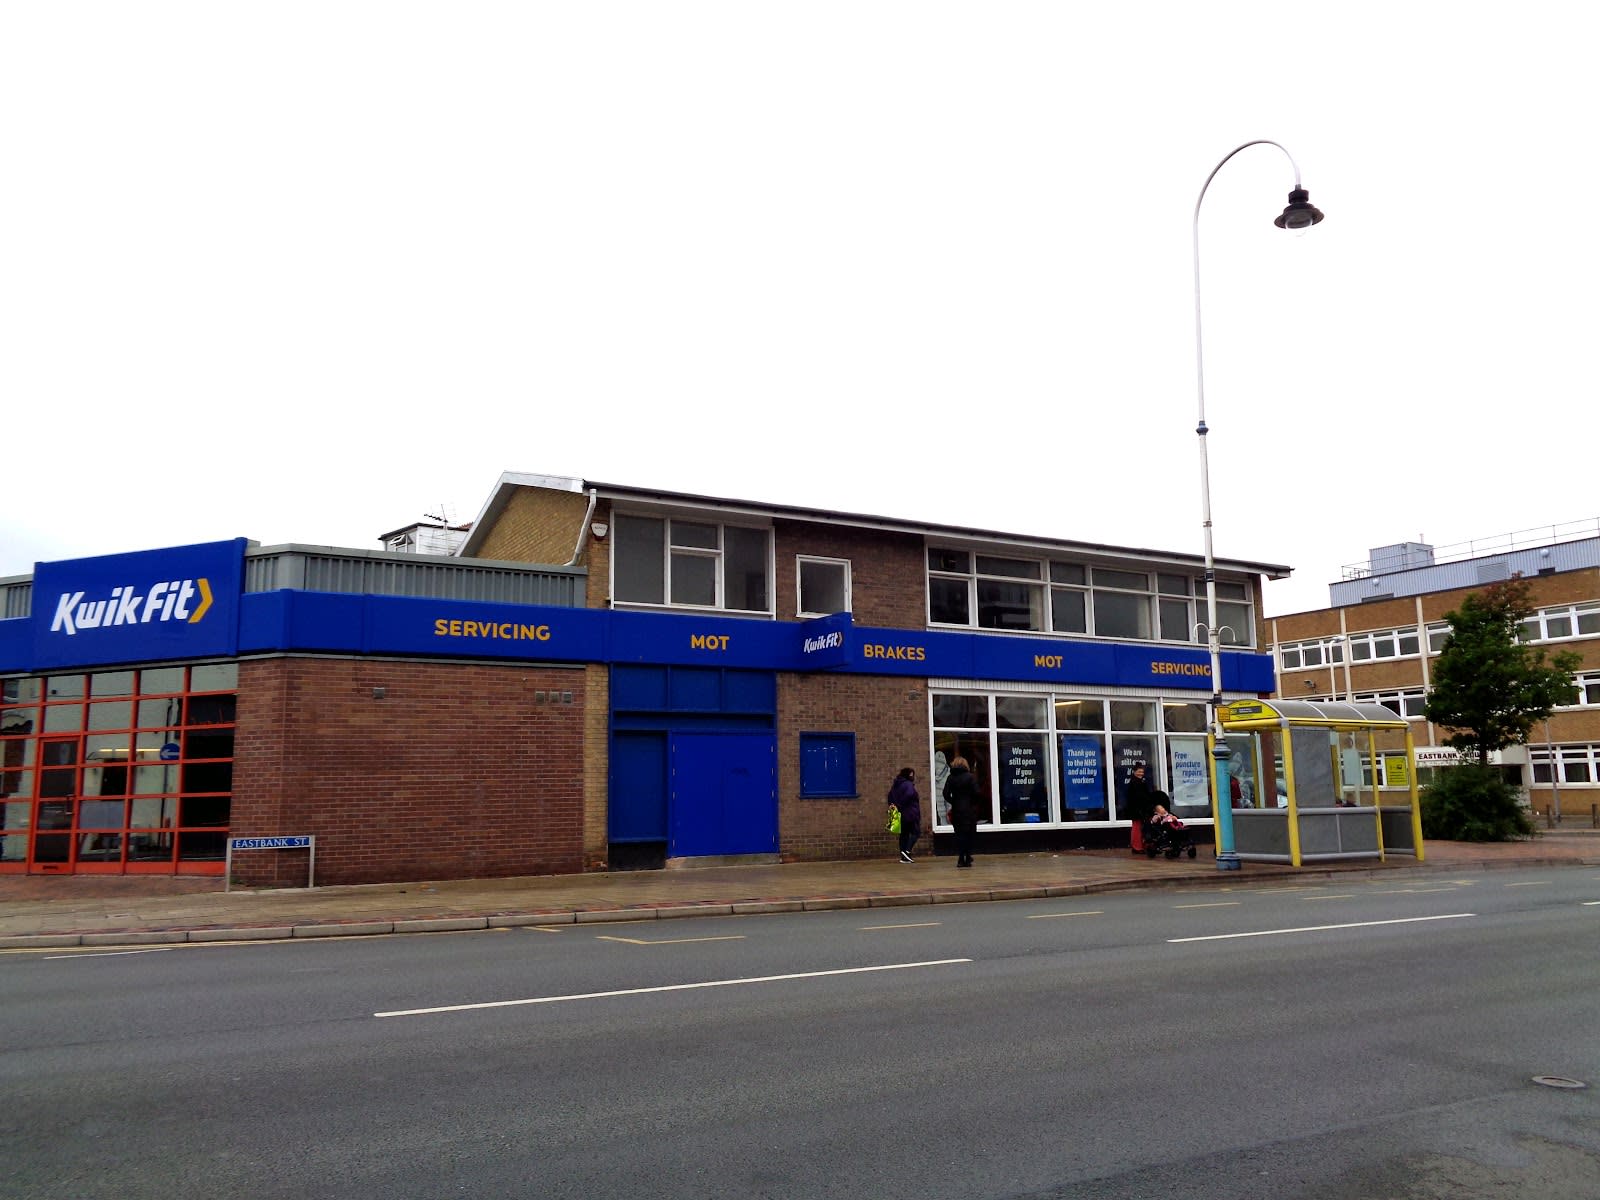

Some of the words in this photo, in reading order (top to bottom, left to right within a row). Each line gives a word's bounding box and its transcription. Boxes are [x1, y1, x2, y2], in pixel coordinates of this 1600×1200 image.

[50, 585, 143, 636] Kwik
[140, 579, 195, 623] Fit
[434, 618, 551, 641] SERVICING
[691, 634, 730, 650] MOT
[803, 635, 826, 654] Kwik
[825, 631, 839, 648] Fit
[863, 644, 926, 661] BRAKES
[1034, 654, 1063, 669] MOT
[1151, 661, 1212, 676] SERVICING
[1011, 747, 1022, 755] We
[1067, 749, 1084, 757] Thank
[1085, 750, 1096, 758] you
[1123, 748, 1133, 756] We
[1174, 751, 1188, 760] Free
[1418, 752, 1458, 760] EASTBANK
[1009, 757, 1021, 766] still
[1022, 758, 1036, 767] open
[1067, 759, 1073, 767] to
[1074, 759, 1083, 767] the
[1084, 759, 1096, 767] NHS
[1175, 760, 1201, 770] puncture
[1015, 767, 1021, 775] if
[1021, 769, 1032, 777] you
[1012, 777, 1027, 785] need
[1072, 776, 1095, 784] workers
[235, 838, 288, 848] EASTBANK
[294, 837, 307, 846] ST
